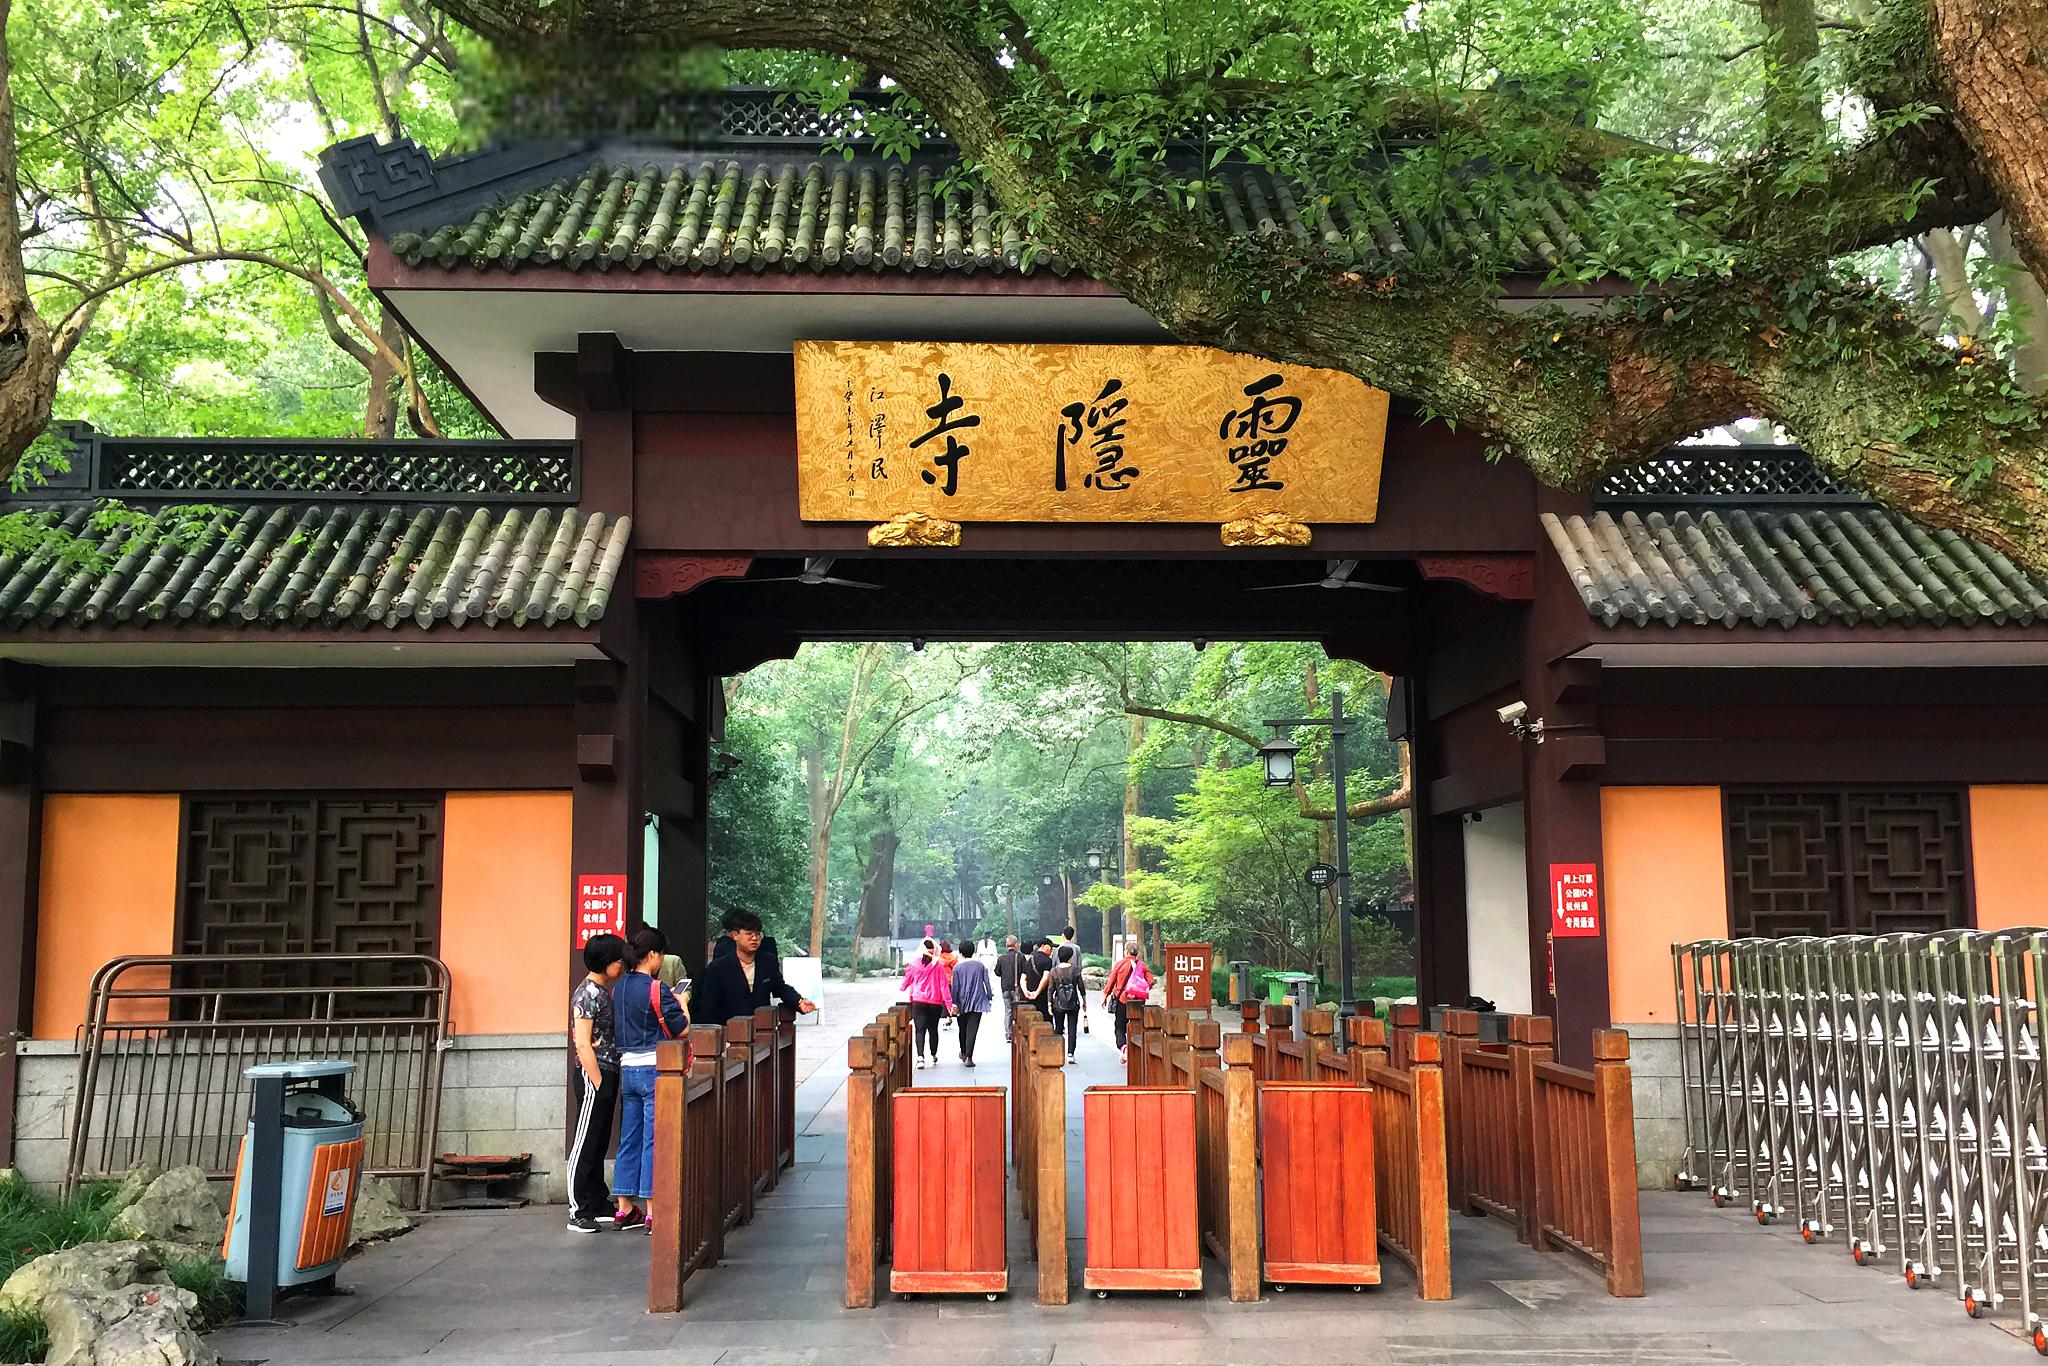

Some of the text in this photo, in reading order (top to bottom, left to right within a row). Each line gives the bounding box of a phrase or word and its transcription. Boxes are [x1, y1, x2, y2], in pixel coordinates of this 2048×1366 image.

[869, 387, 888, 480] 江澤民
[909, 373, 1302, 497] 靈隱寺
[1563, 874, 1593, 885] 网上订票
[583, 885, 614, 896] 网上订票
[1174, 954, 1204, 972] 出口
[1178, 974, 1201, 984] EXIT
